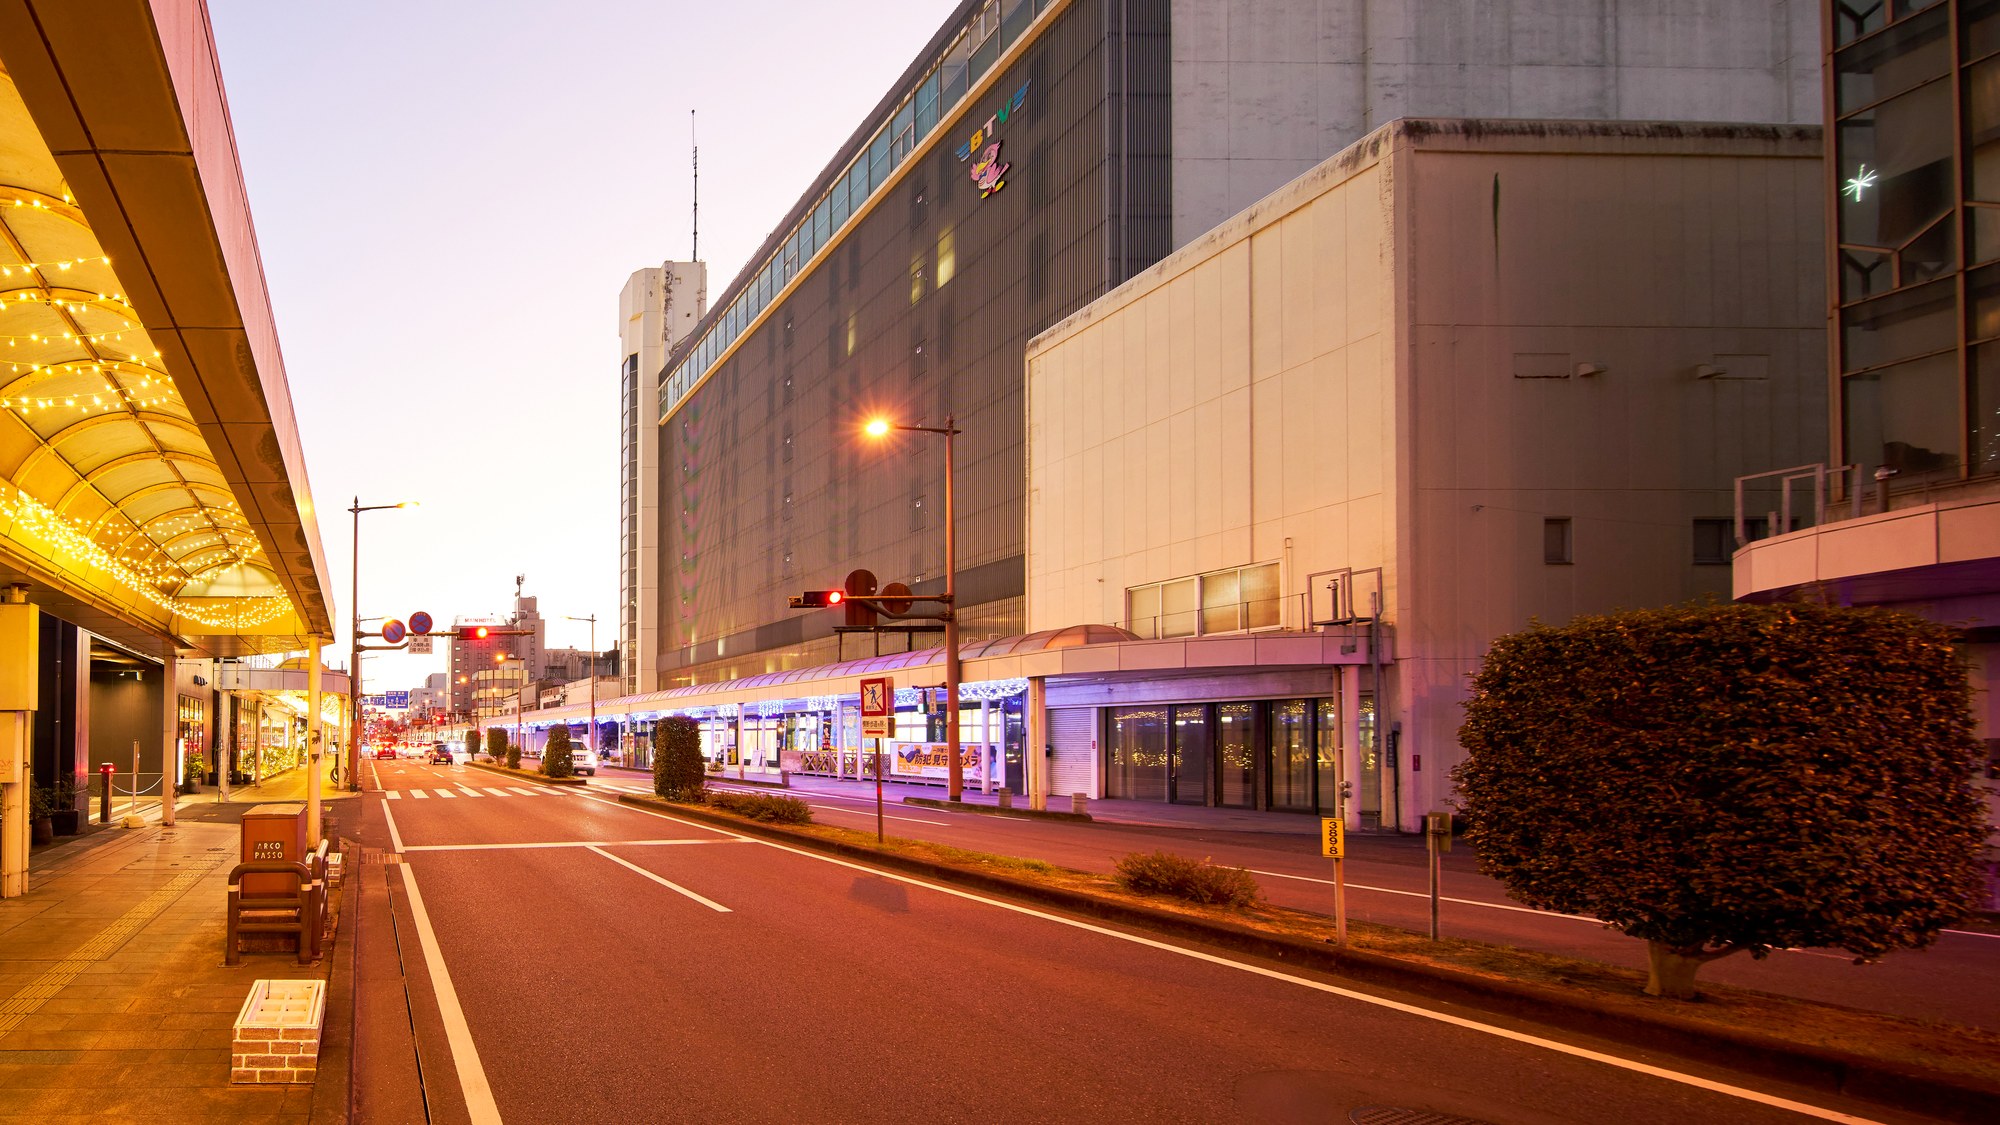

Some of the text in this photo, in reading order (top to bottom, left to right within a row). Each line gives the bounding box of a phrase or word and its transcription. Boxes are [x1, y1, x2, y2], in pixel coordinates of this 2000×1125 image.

[970, 98, 1013, 154] BTV
[257, 842, 281, 850] ARCO
[254, 851, 283, 860] PASSO
